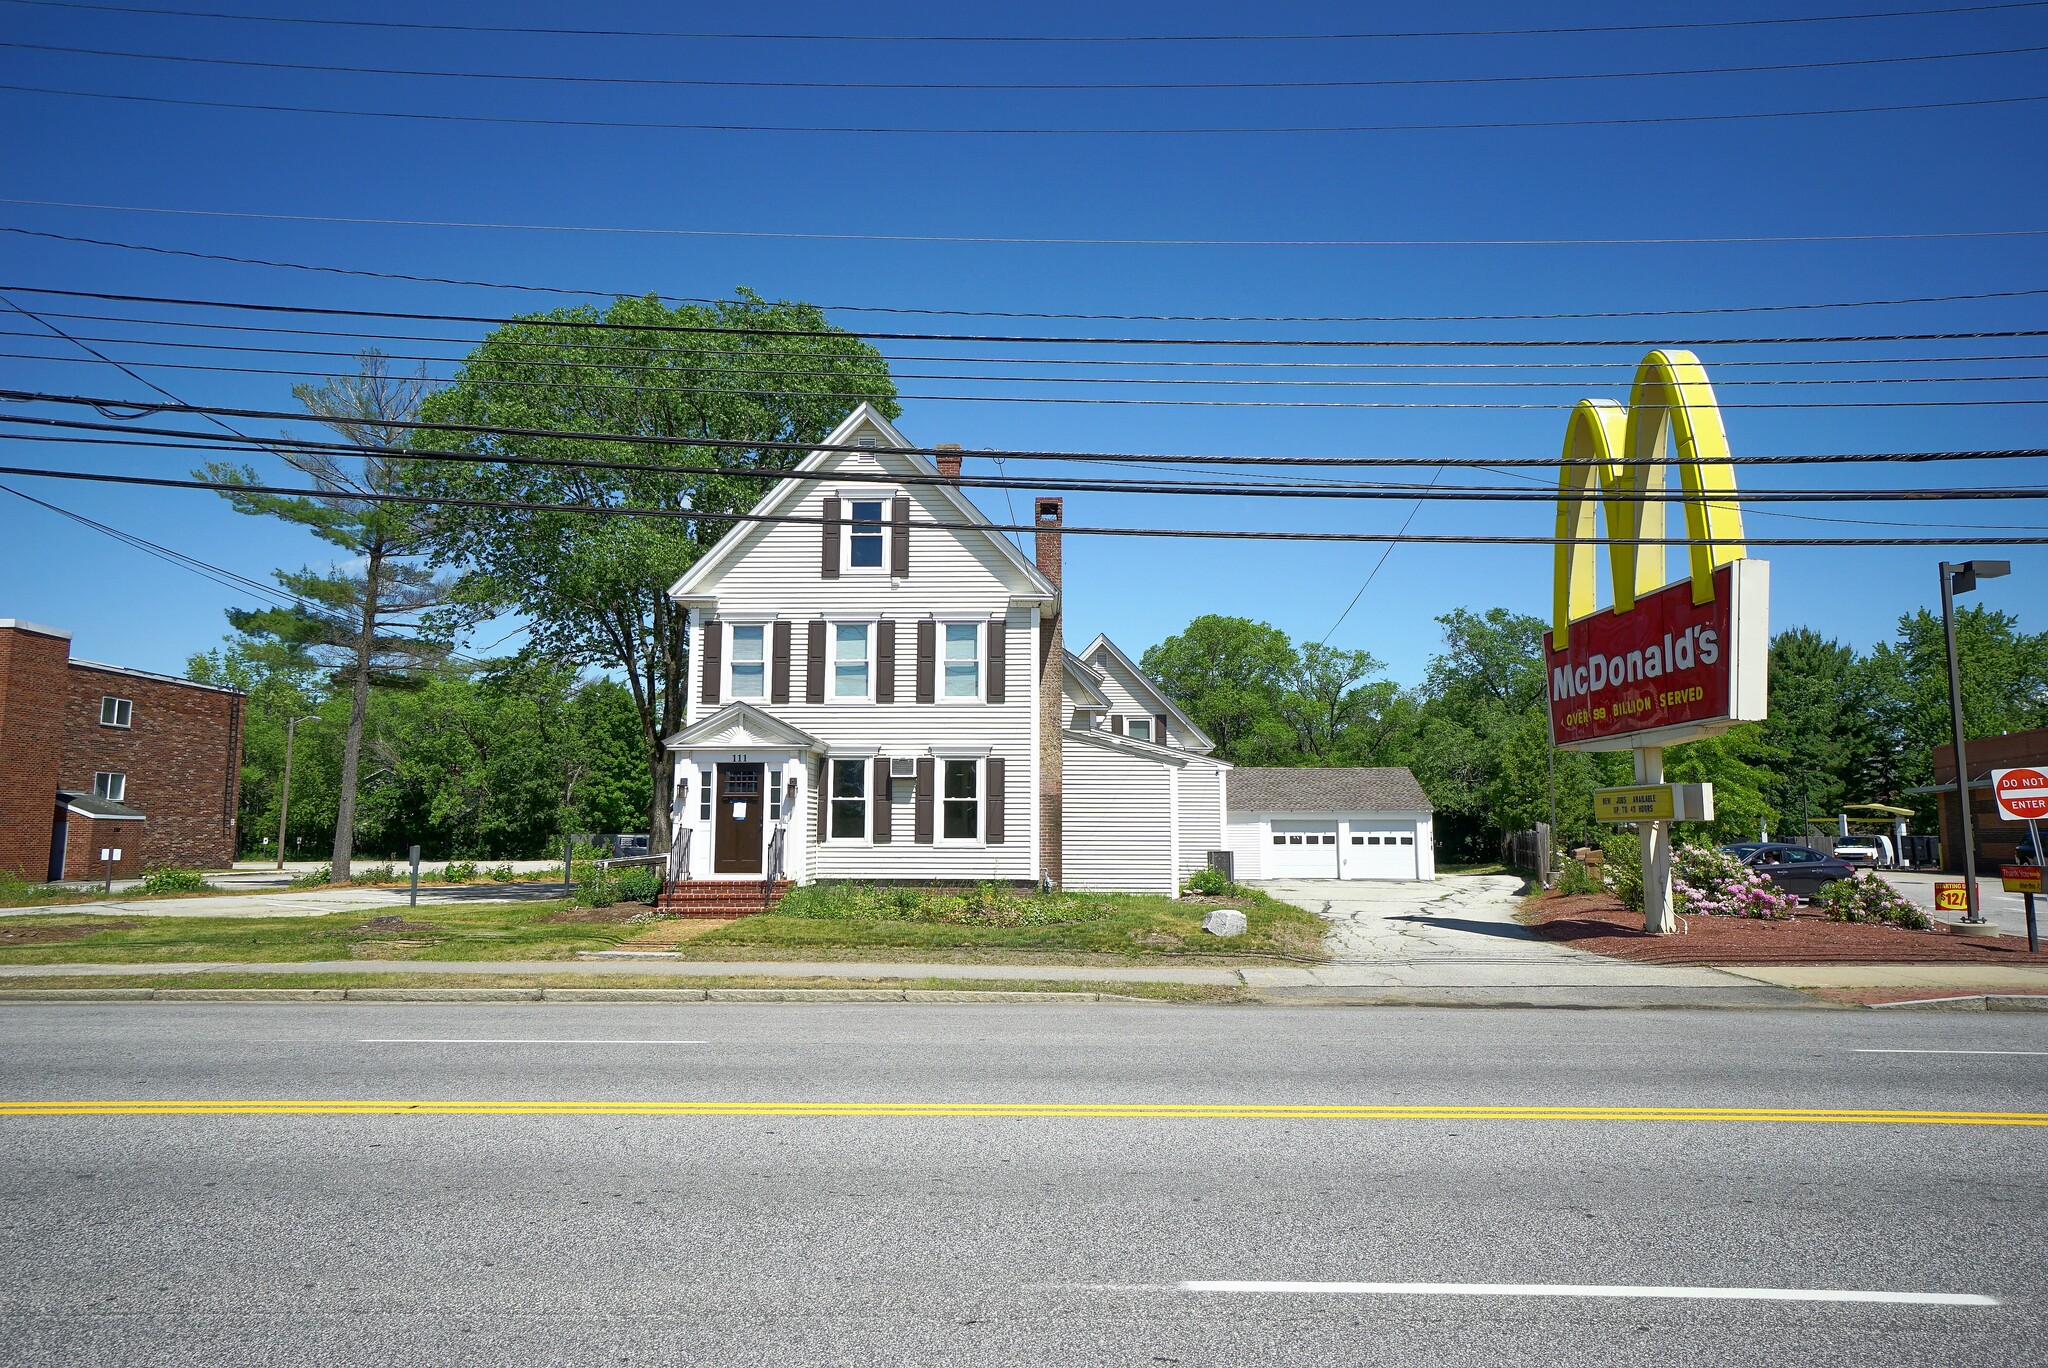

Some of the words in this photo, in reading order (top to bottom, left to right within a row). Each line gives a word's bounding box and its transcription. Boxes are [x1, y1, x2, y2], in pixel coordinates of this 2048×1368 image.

[1553, 624, 1719, 701] McDonald's
[1566, 708, 1589, 727] OVER
[1593, 708, 1606, 720] 99
[1613, 697, 1651, 717] BILLION
[1660, 686, 1704, 708] SERVED
[732, 754, 748, 762] 111
[2002, 779, 2018, 788] DO
[2022, 777, 2044, 787] NOT
[2011, 800, 2046, 809] ENTER
